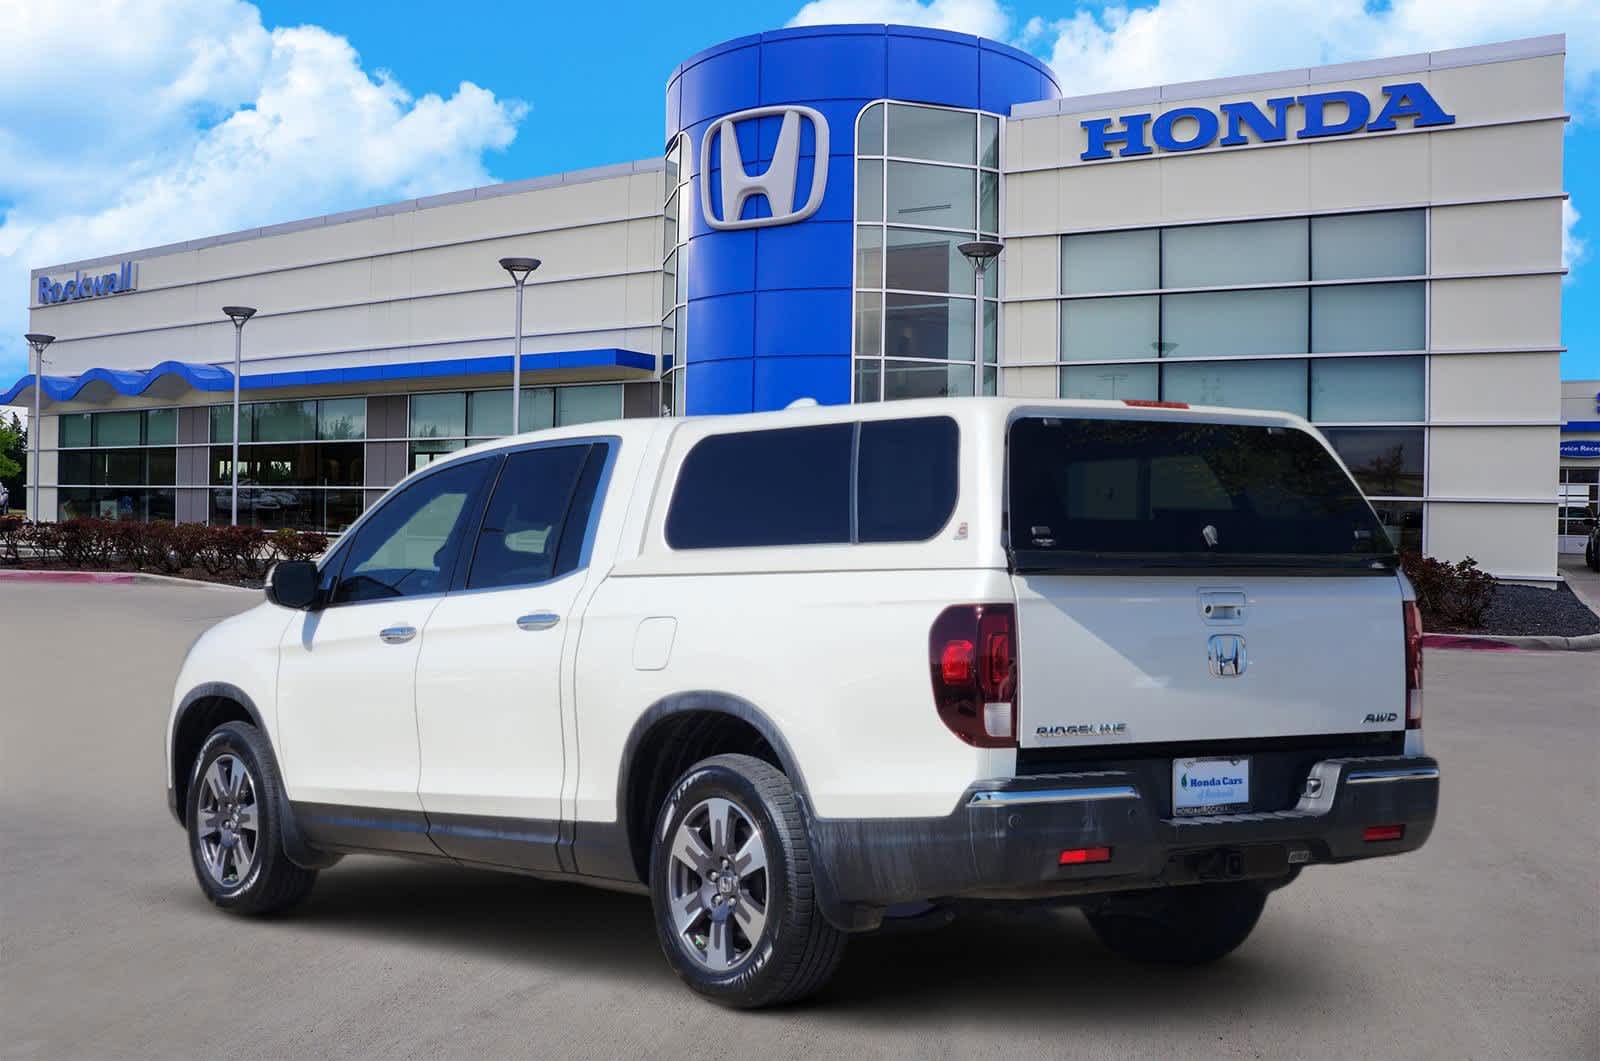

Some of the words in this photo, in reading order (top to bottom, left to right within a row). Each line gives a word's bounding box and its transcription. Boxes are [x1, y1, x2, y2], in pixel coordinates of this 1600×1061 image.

[1080, 82, 1456, 161] HONDA
[38, 260, 132, 304] Rockwall
[1362, 712, 1398, 723] AWD
[1035, 722, 1128, 737] RIDGELINE
[1190, 777, 1221, 788] Honda
[1222, 777, 1243, 786] Cars
